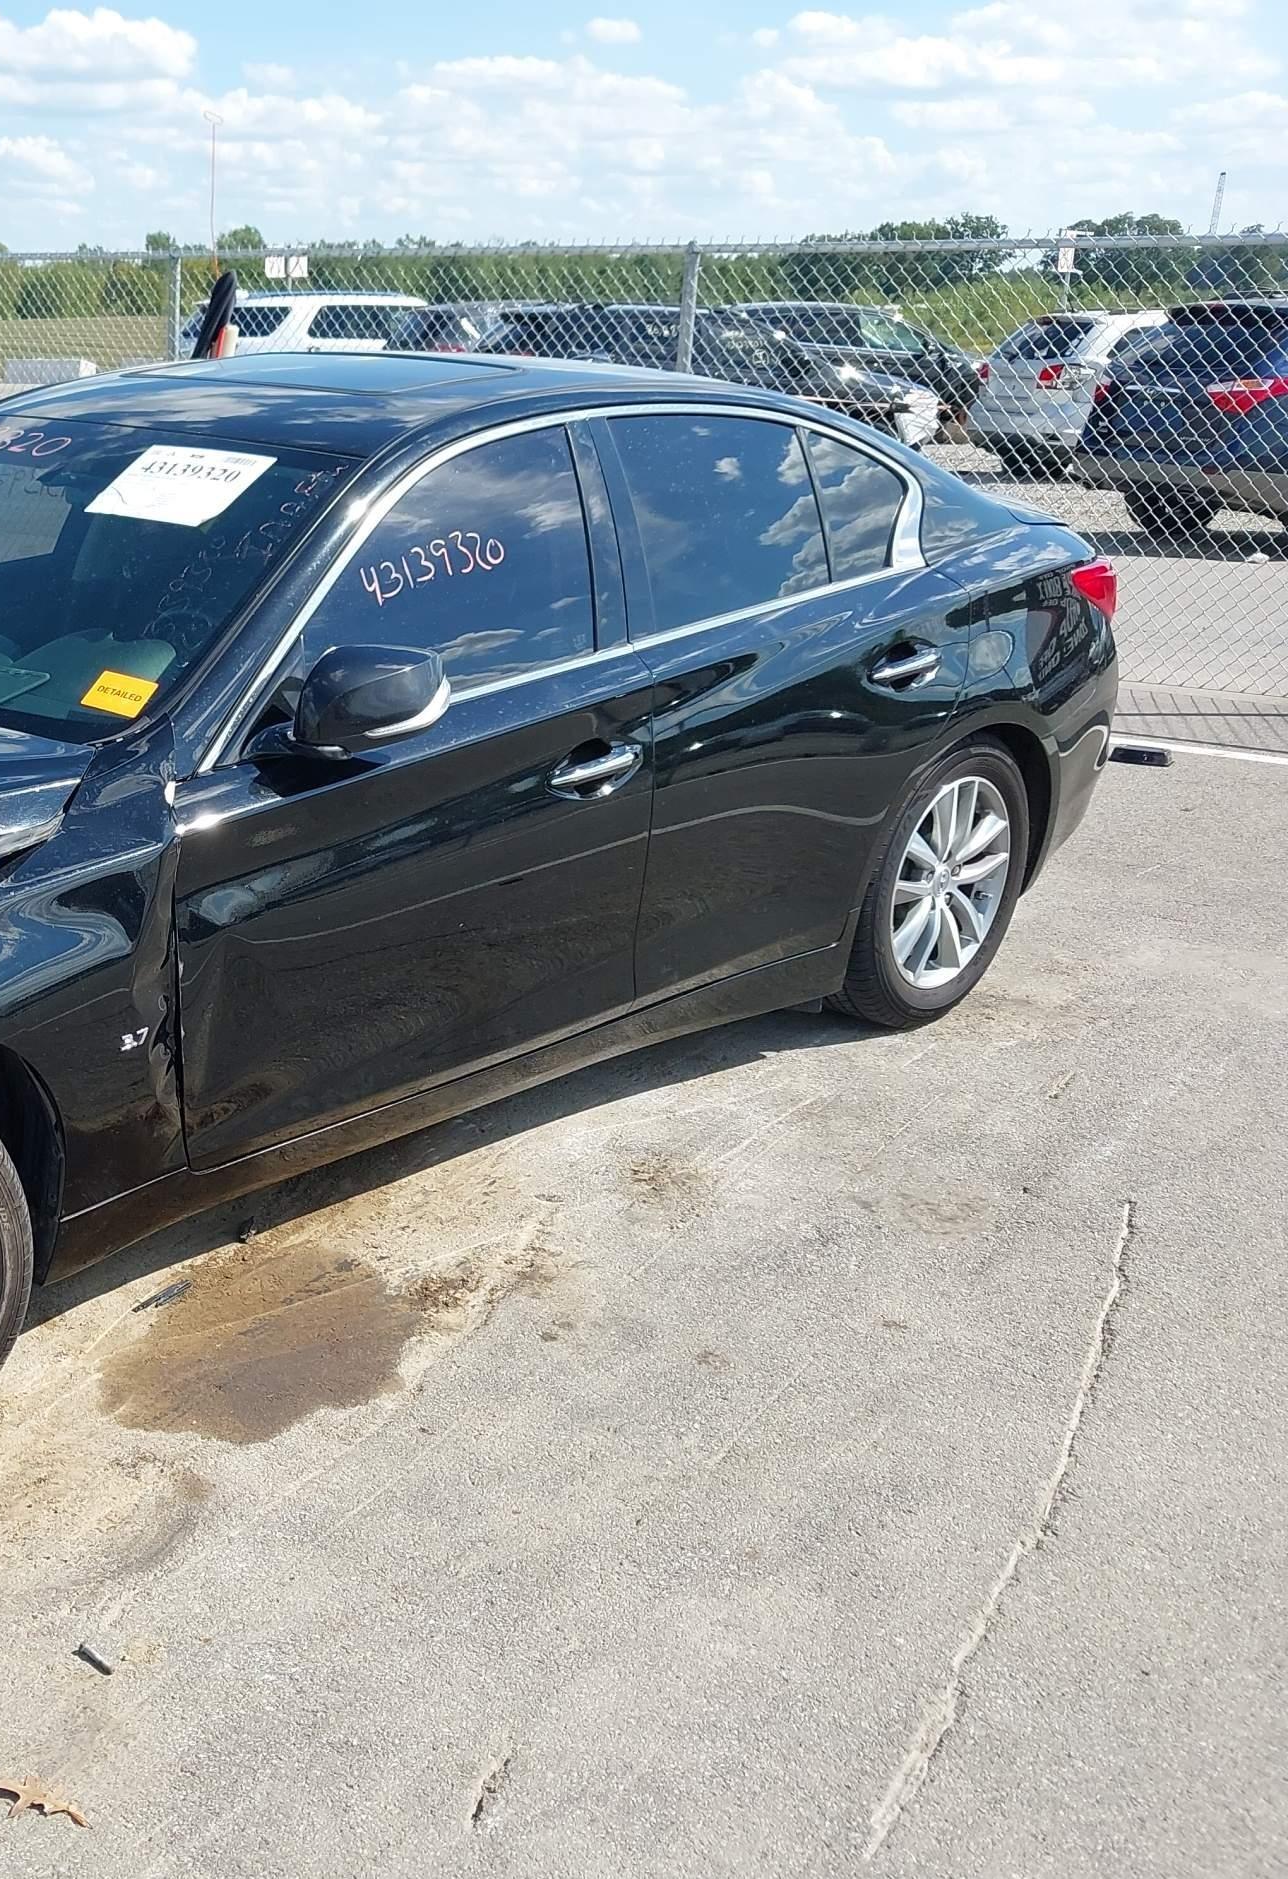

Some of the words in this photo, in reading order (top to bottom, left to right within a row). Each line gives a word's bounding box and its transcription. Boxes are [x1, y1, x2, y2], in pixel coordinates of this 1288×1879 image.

[141, 460, 241, 483] 43139320
[360, 531, 505, 607] 43139320
[96, 685, 143, 702] DETAILED
